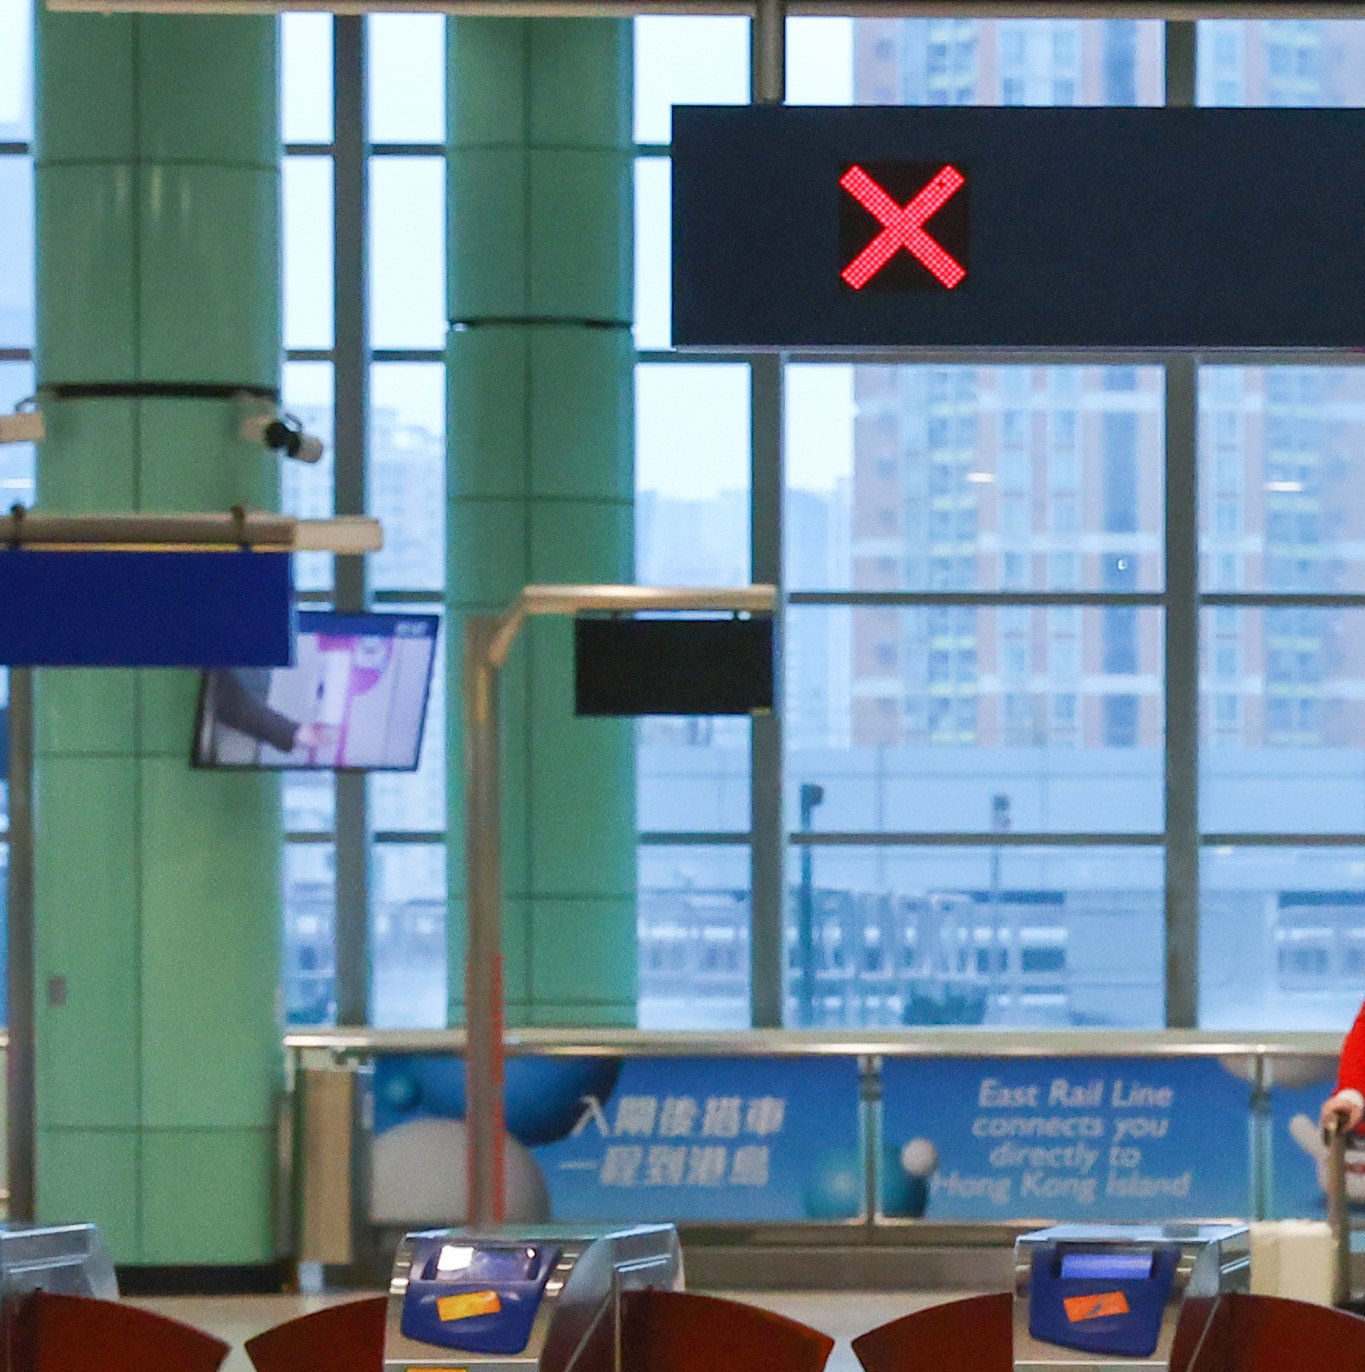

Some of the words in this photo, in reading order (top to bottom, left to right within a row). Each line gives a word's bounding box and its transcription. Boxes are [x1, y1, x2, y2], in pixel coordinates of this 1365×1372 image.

[978, 1078, 1039, 1107] East
[1049, 1078, 1103, 1107] Rail
[1112, 1079, 1173, 1108] Line
[971, 1117, 1104, 1137] connects
[1112, 1118, 1169, 1143] you
[989, 1142, 1098, 1174] directly
[1109, 1143, 1141, 1168] to
[930, 1171, 1010, 1204] Hong
[1020, 1171, 1097, 1203] Kong
[1106, 1168, 1191, 1198] Island
